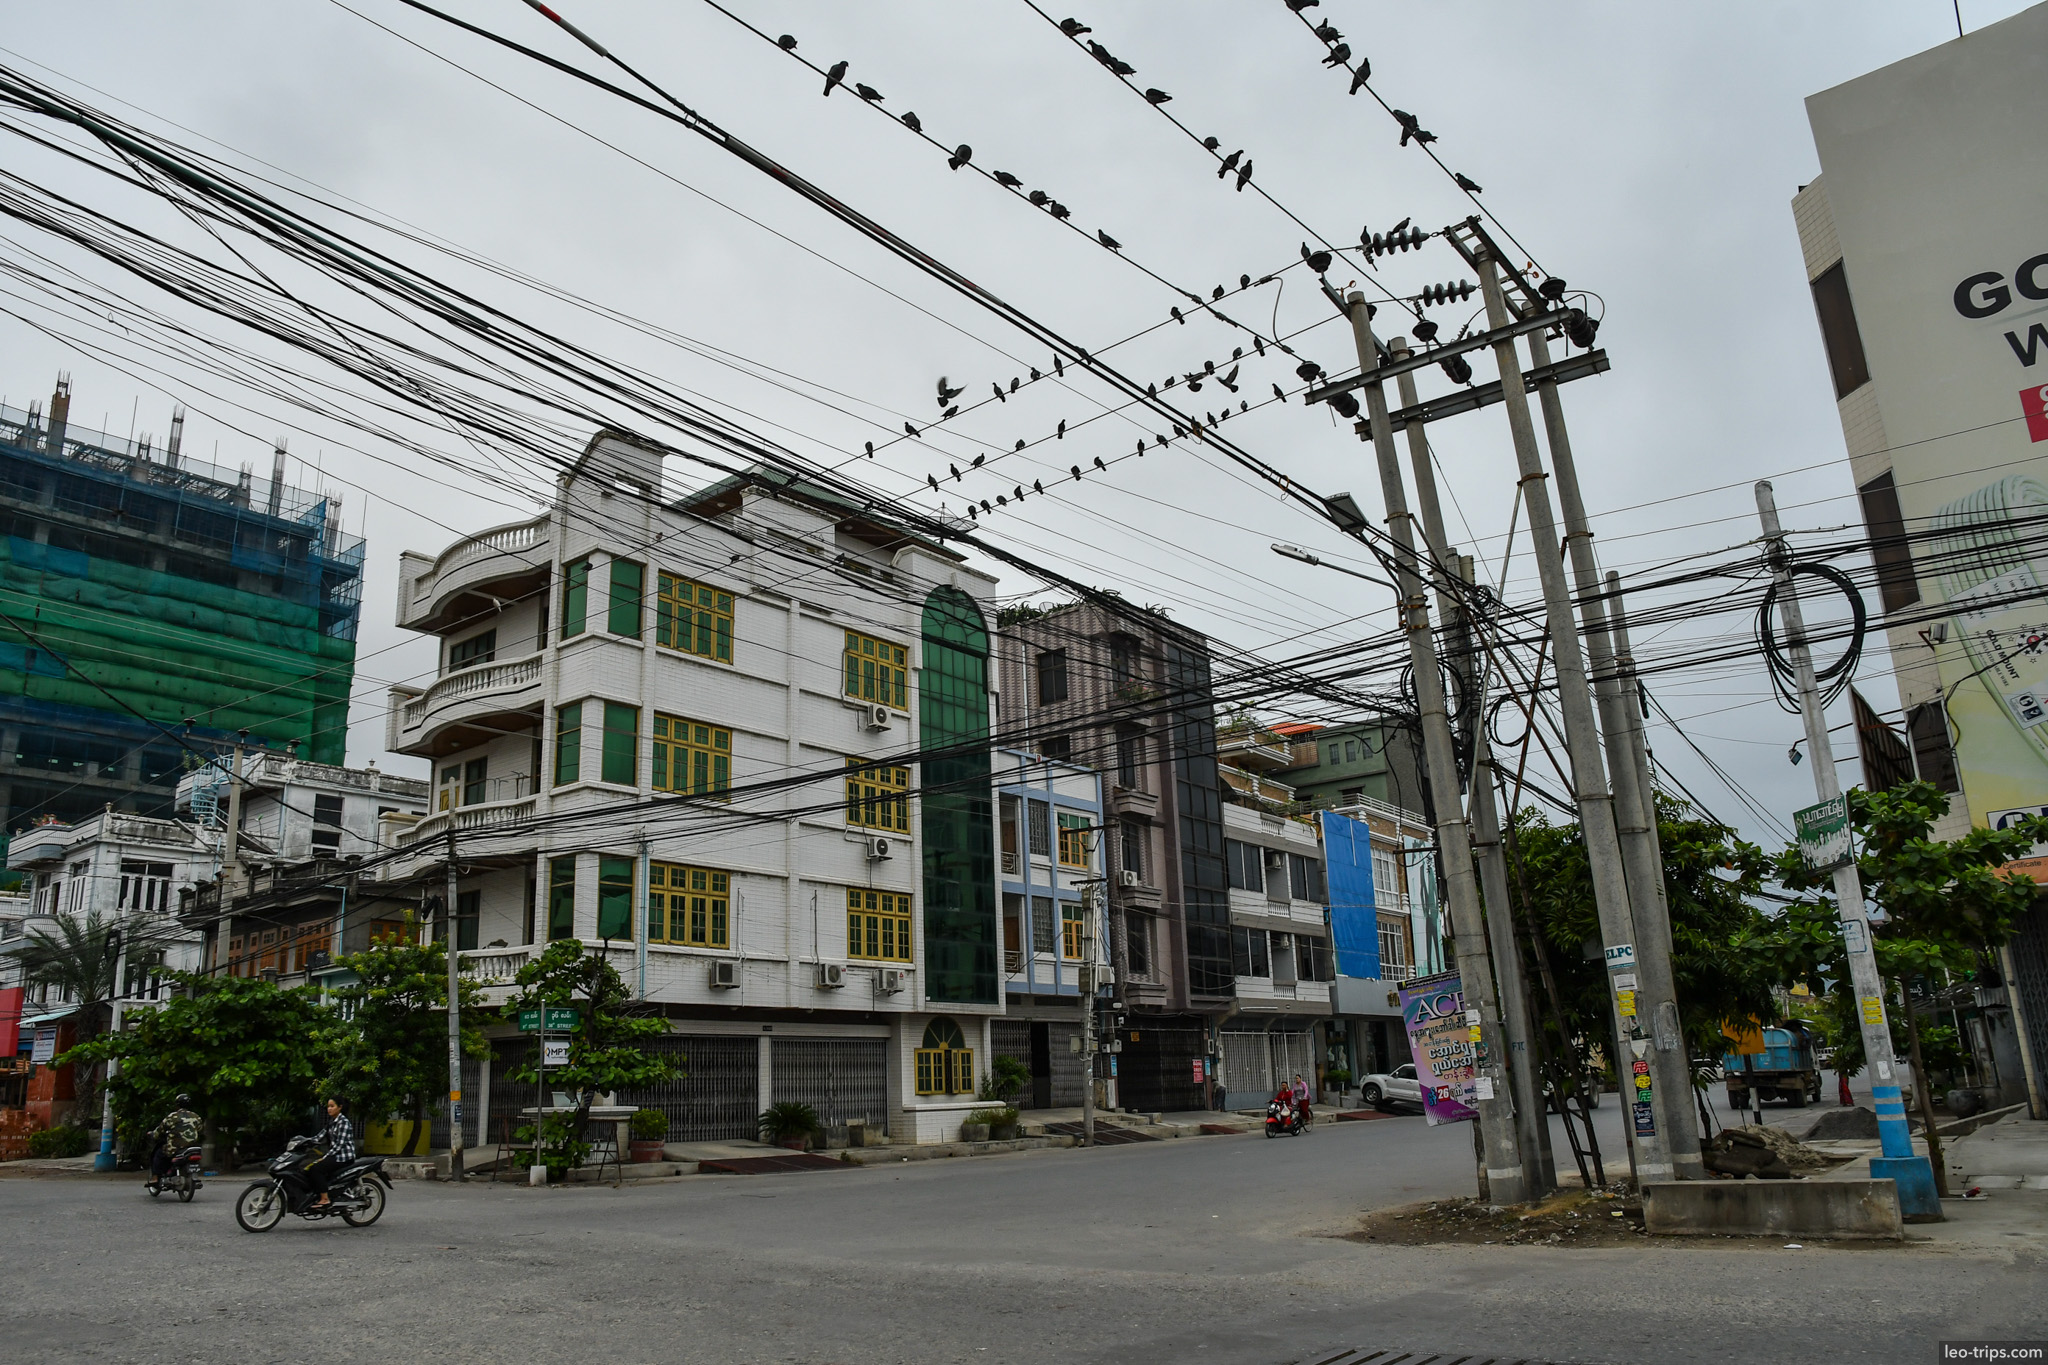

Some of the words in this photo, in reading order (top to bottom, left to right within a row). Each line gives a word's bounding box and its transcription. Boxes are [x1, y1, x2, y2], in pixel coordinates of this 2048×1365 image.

[1986, 629, 2001, 651] GOLD
[1998, 651, 2020, 680] MOUNT
[2003, 861, 2042, 870] Certificate
[1605, 946, 1632, 960] ELPC
[550, 1047, 567, 1056] MPT
[1437, 1088, 1449, 1100] 26
